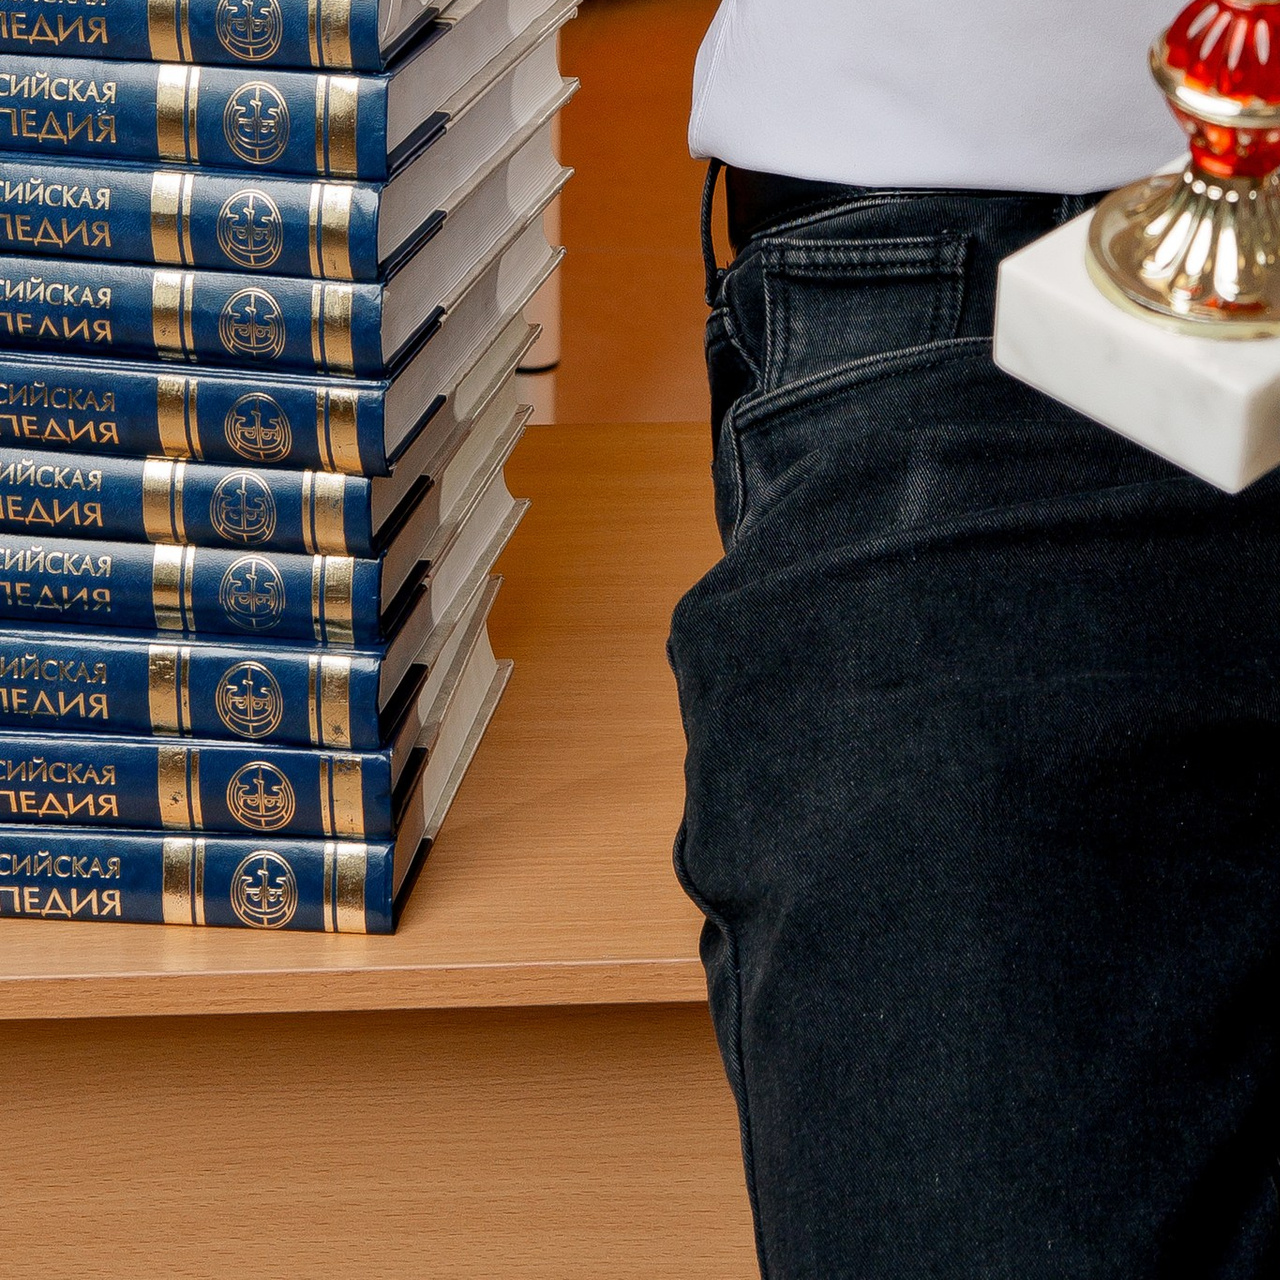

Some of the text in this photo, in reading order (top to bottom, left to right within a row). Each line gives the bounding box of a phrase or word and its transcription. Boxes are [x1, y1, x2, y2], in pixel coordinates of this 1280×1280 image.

[0, 71, 117, 104] СИЙСКАЯ
[0, 107, 117, 144] ПЕДИЯ
[0, 178, 111, 210] ИЙСКАЯ
[0, 277, 112, 309] ИЙСКАЯ
[0, 414, 120, 444] ПЕДИЯ
[0, 495, 104, 527] ЕДИЯ
[0, 545, 112, 577] ИЙСКАЯ
[0, 653, 107, 684] ИЙСКАЯ
[0, 790, 119, 818] ПЕДИЯ
[0, 851, 121, 879] СИЙСКАЯ
[0, 886, 122, 918] ПЕДИЯ
